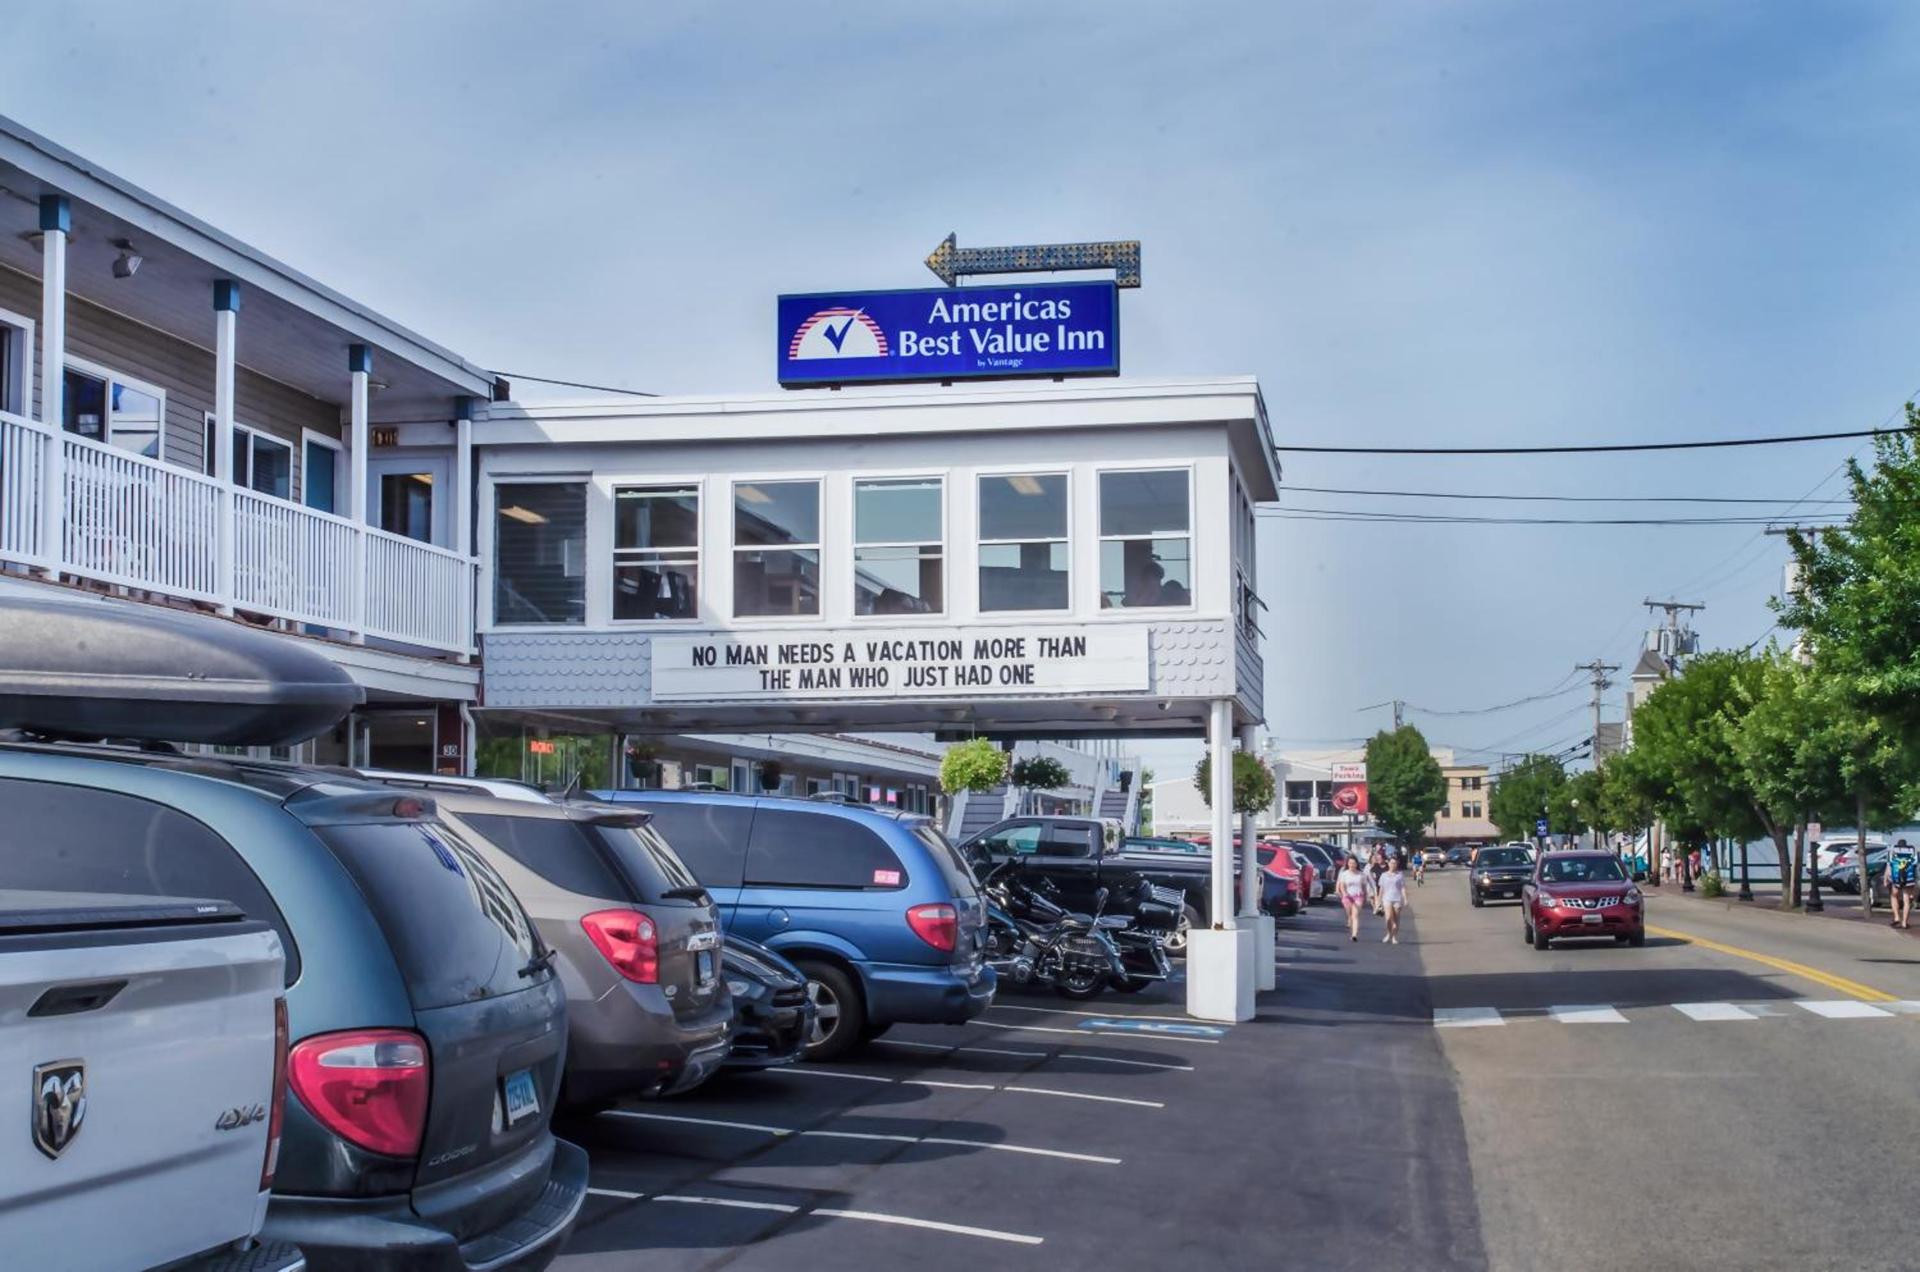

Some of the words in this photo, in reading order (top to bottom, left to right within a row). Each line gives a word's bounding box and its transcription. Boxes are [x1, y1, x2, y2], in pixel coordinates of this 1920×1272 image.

[928, 291, 1072, 324] Americas
[899, 330, 962, 357] Best
[968, 324, 1051, 354] Value
[1057, 324, 1105, 351] Inn
[977, 359, 986, 368] by
[987, 357, 1024, 368] Vantage
[691, 645, 718, 666] NO
[726, 644, 769, 665] MAN
[778, 643, 834, 664] NEEDS
[843, 642, 856, 663] A
[866, 640, 962, 662] VACATION
[973, 637, 1026, 660] MORE
[1037, 636, 1087, 658] THAN
[758, 669, 791, 690] THE
[798, 668, 841, 689] MAN
[849, 667, 889, 688] WHO
[903, 666, 949, 687] JUST
[955, 665, 993, 686] HAD
[999, 664, 1035, 685] ONE
